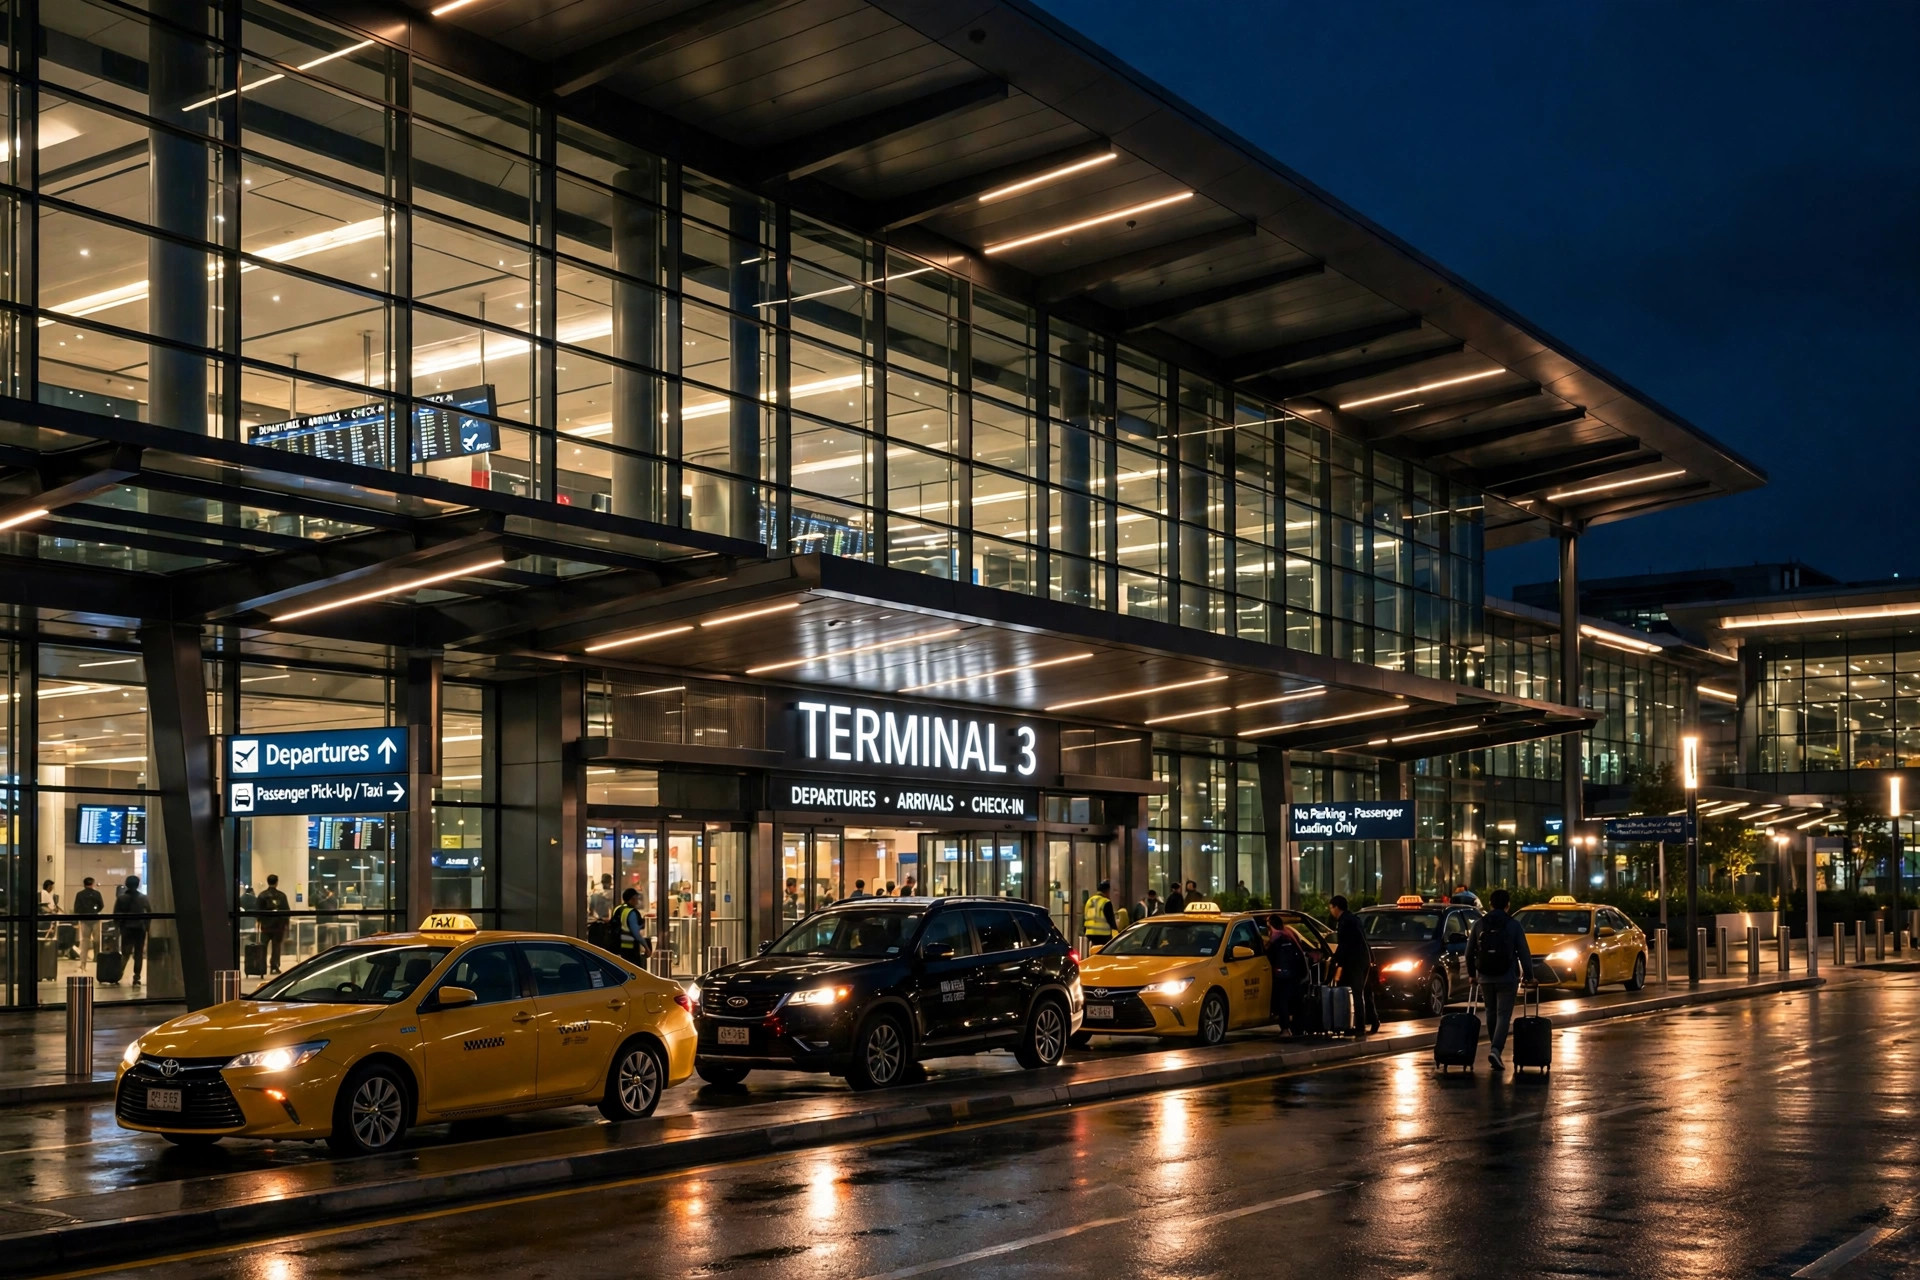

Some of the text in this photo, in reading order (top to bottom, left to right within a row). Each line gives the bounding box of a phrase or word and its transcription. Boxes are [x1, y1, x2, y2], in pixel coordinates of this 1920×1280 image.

[798, 701, 1037, 776] TERMINAL 3
[266, 743, 369, 770] Departures
[257, 787, 309, 803] Passenger
[311, 783, 352, 801] Pick-Up
[361, 782, 383, 798] Taxi
[791, 786, 1024, 815] DEPARTURES ARRIVALS CHECK-IN
[1294, 808, 1309, 820] No
[1354, 807, 1403, 820] Passenger
[1295, 822, 1357, 836] Loading Only
[431, 916, 456, 928] TAXI
